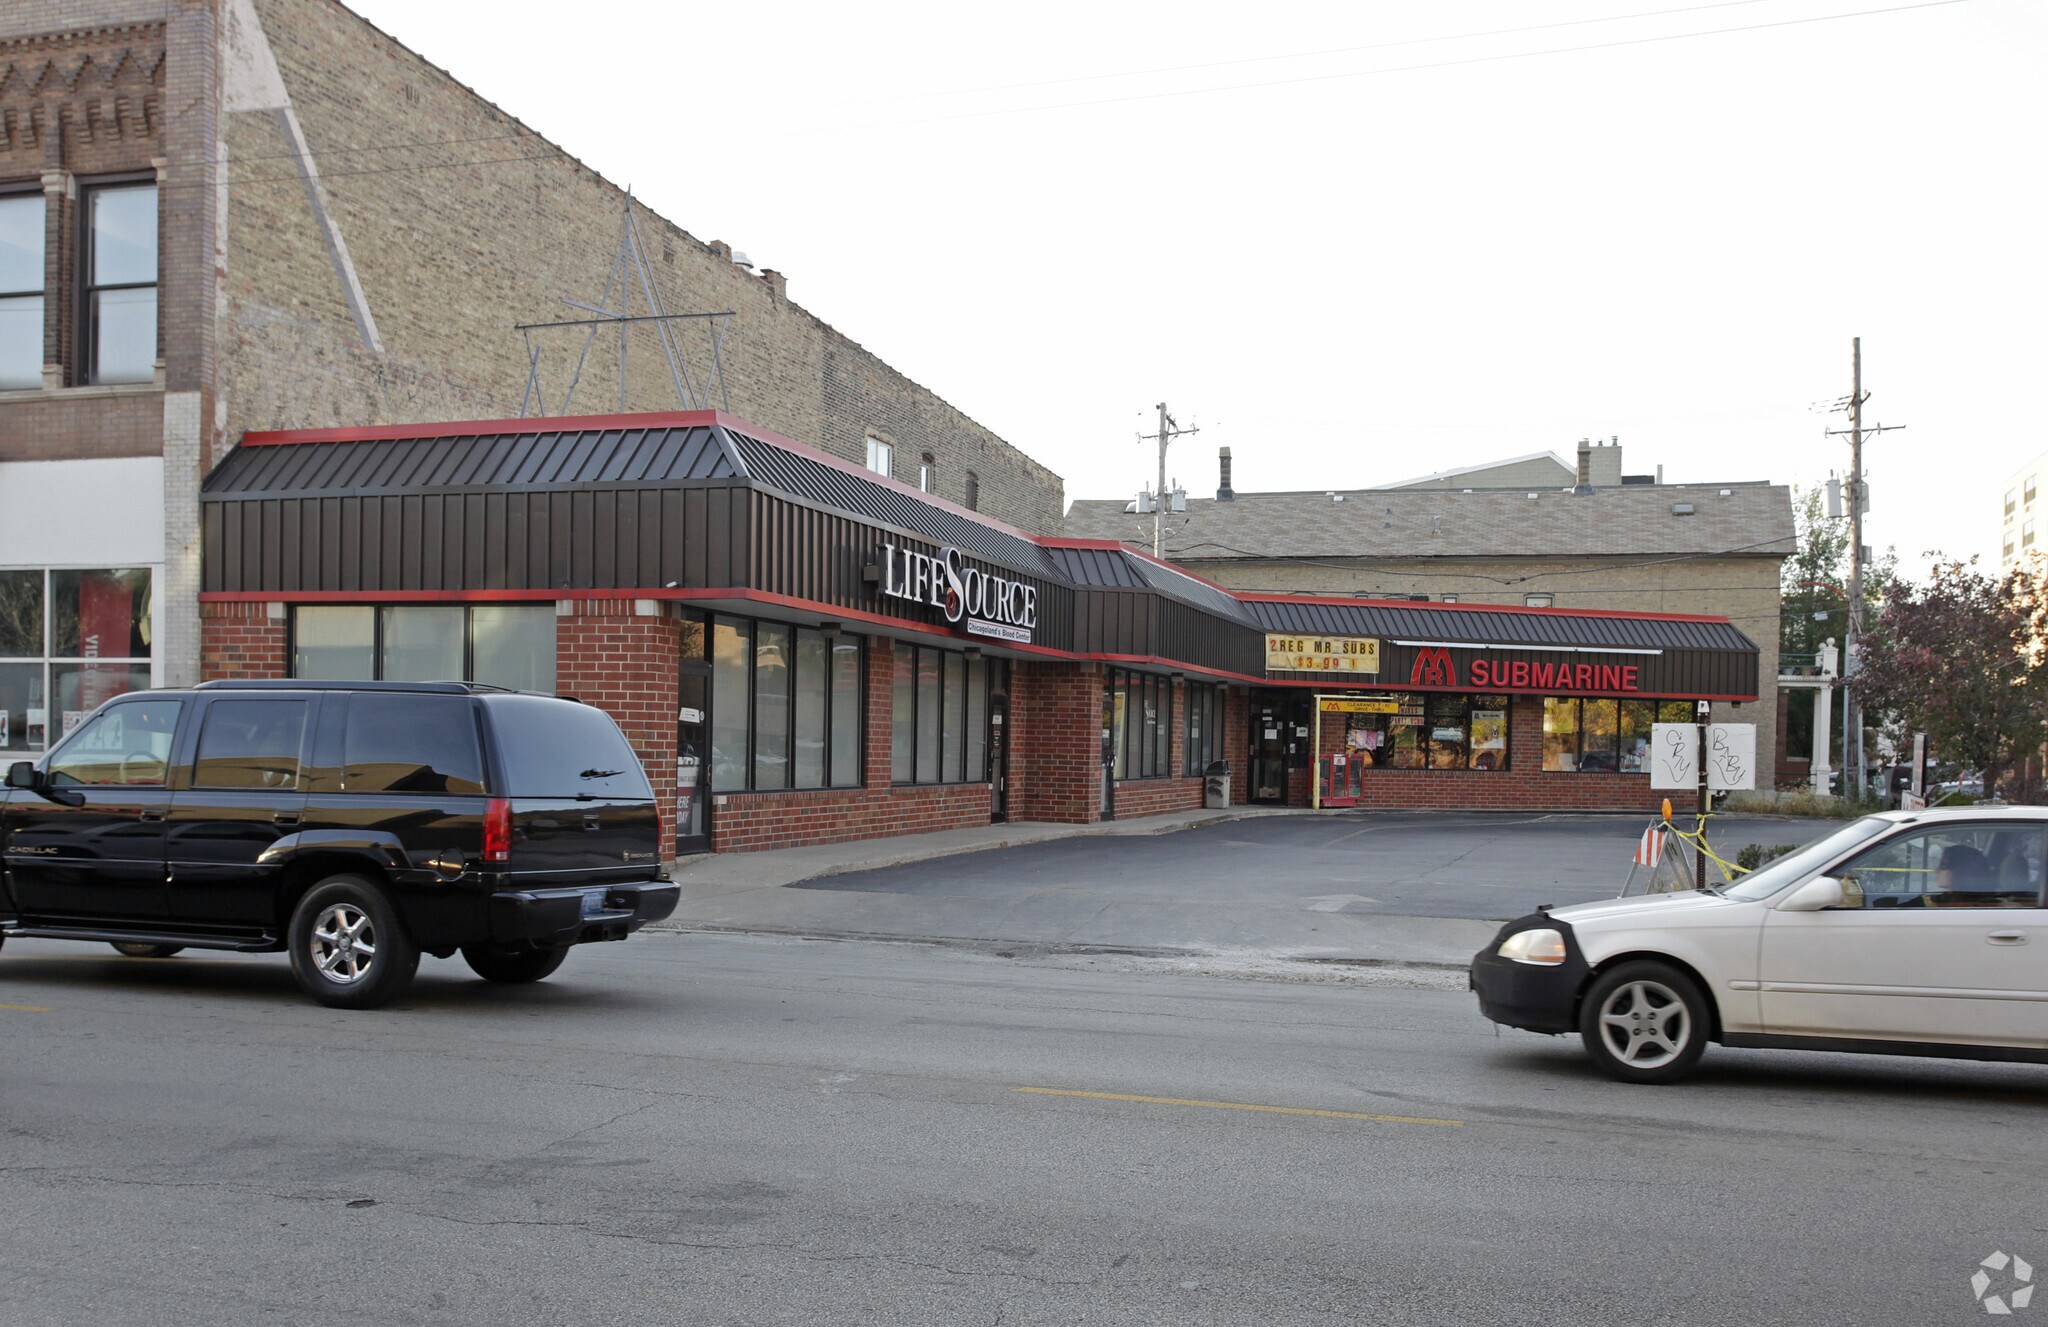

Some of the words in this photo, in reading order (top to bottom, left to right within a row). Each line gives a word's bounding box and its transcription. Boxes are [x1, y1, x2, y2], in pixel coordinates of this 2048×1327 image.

[1002, 629, 1015, 638] Blood
[1016, 631, 1030, 641] Center
[1314, 641, 1331, 653] MR
[1343, 642, 1375, 655] SUBS
[1297, 656, 1340, 670] $3.99
[1471, 659, 1639, 691] SUBMARINE
[8, 846, 59, 854] CADILLAC
